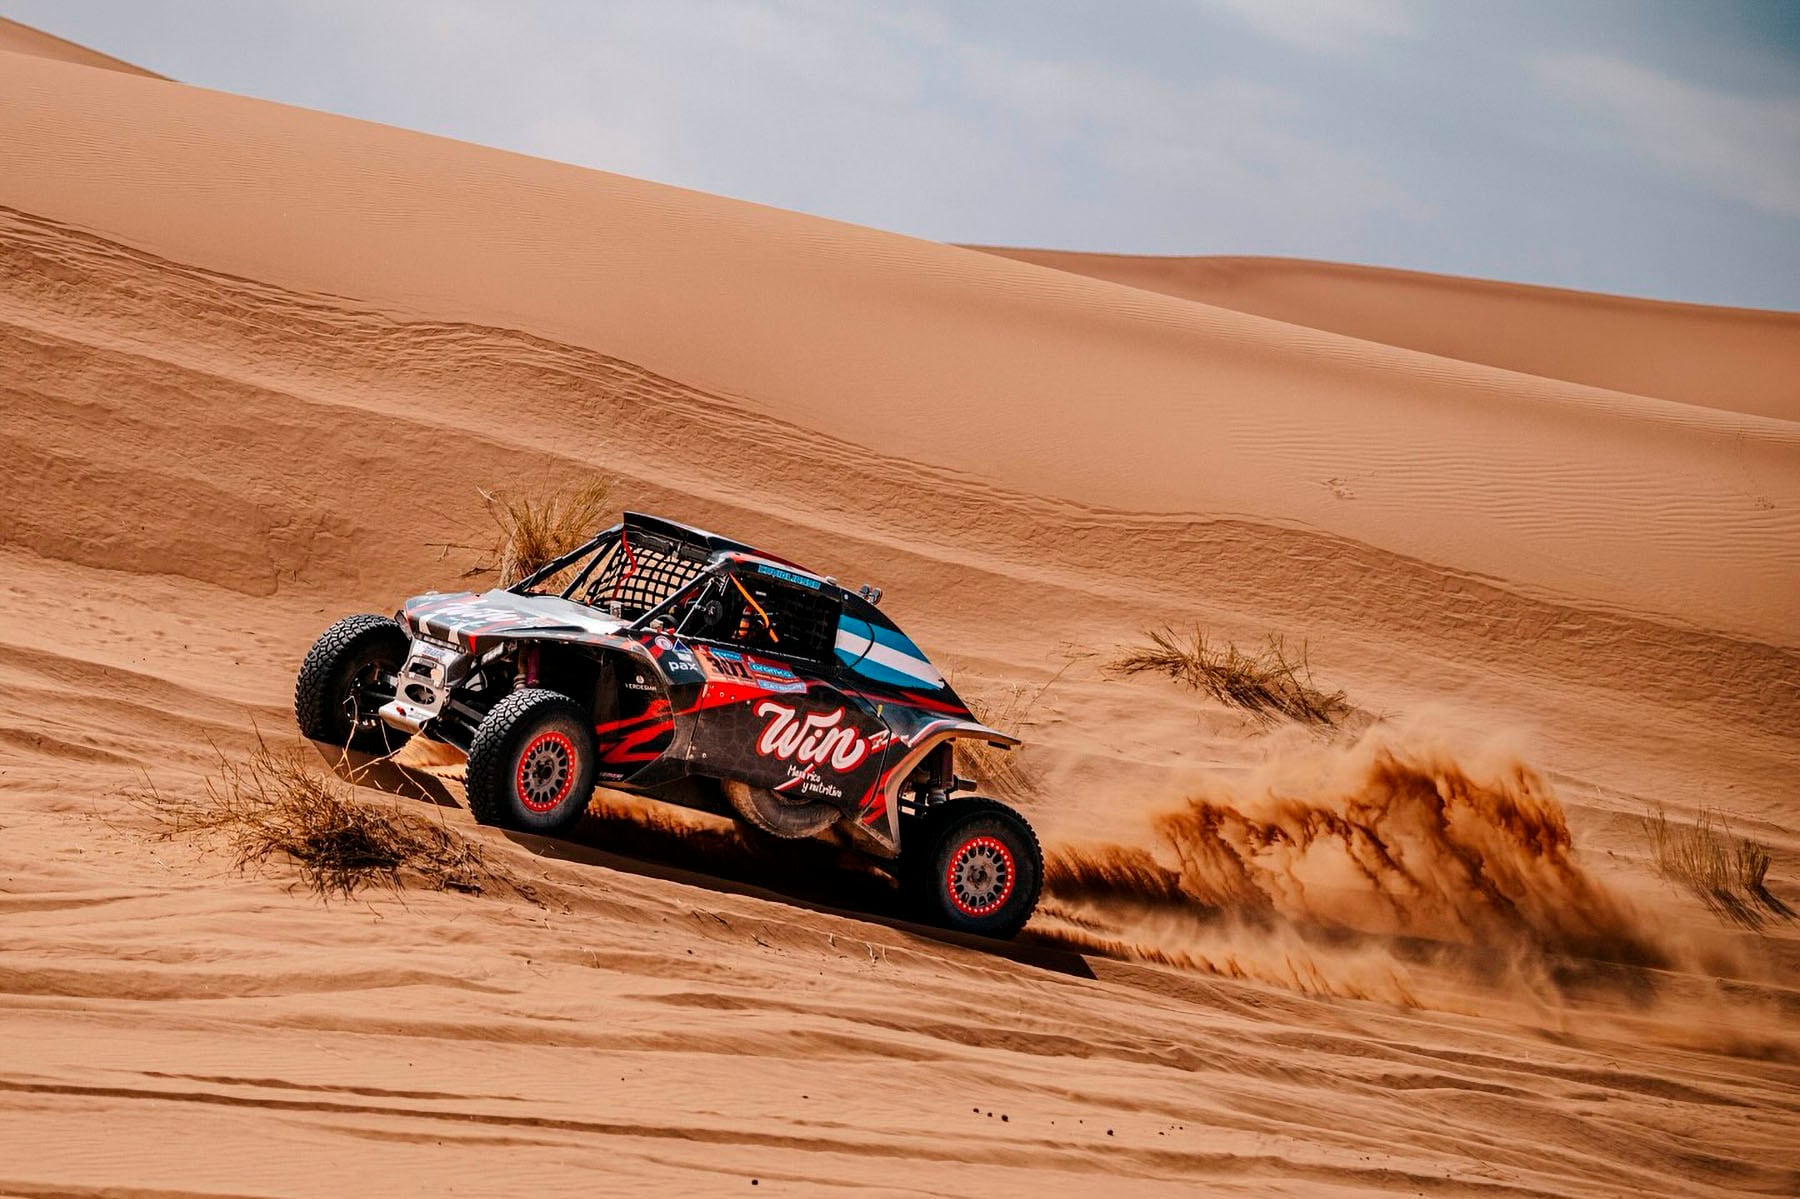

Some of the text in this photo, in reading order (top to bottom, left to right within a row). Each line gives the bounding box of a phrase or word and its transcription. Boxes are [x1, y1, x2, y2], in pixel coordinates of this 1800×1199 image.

[669, 660, 698, 672] pax
[757, 701, 867, 771] Win
[801, 782, 809, 793] y
